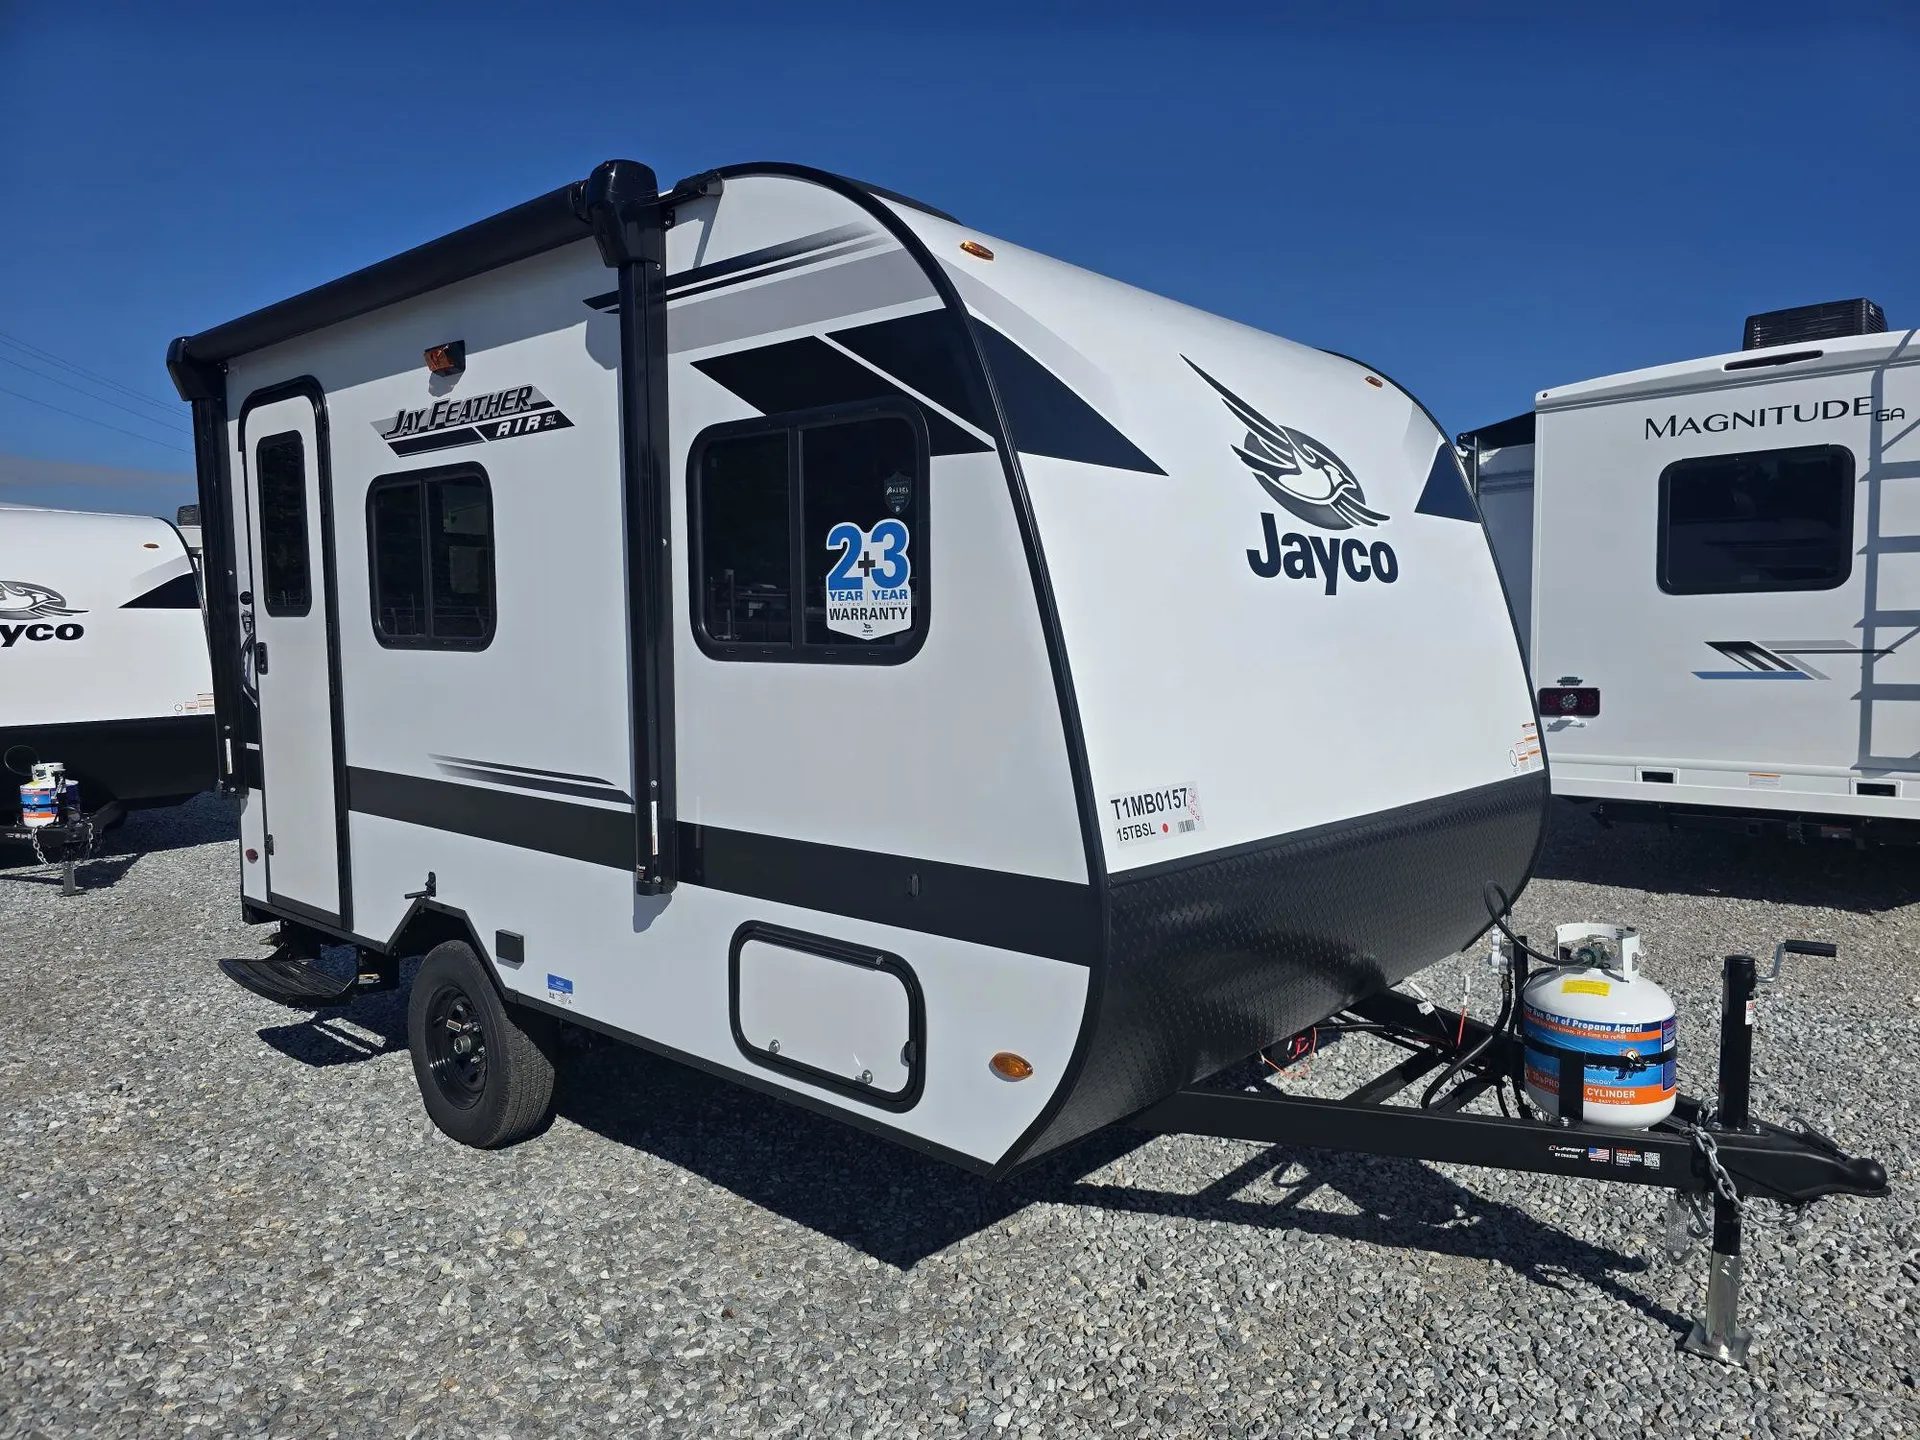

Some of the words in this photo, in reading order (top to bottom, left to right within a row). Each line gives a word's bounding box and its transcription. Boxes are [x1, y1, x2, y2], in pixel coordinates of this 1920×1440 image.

[385, 408, 427, 438] JAY
[428, 384, 534, 430] FEATHER
[1645, 395, 1875, 440] MAGNITUDE
[1875, 407, 1906, 422] GA
[496, 415, 541, 437] AIR
[545, 414, 557, 426] SL
[1245, 512, 1399, 596] Jayco
[829, 591, 863, 601] YEAR
[872, 589, 908, 600] YEAR
[828, 607, 908, 621] WARRANTY
[0, 623, 85, 648] yco
[1110, 787, 1187, 820] T1MB0157
[1116, 822, 1156, 842] 15TBSL
[1546, 1013, 1559, 1024] Out
[1561, 1018, 1570, 1026] of
[1572, 1019, 1612, 1032] Propane
[1614, 1023, 1643, 1033] Again!
[1587, 1087, 1636, 1099] CYLINDER
